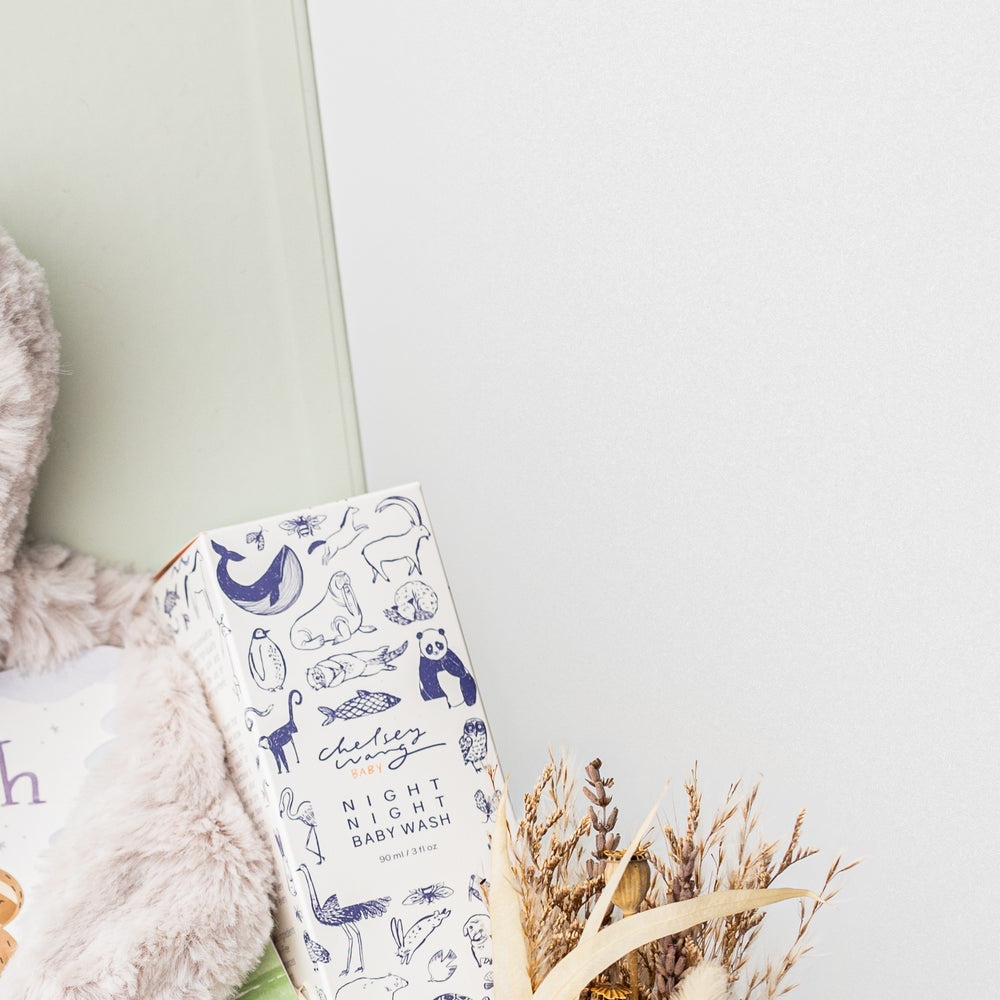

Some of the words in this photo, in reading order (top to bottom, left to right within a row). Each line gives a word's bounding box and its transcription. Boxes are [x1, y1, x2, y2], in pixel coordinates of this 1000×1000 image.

[351, 763, 383, 779] BABY
[342, 778, 440, 813] NIGHT
[347, 795, 445, 830] NIGHT
[352, 826, 395, 848] BABY
[400, 813, 451, 835] WASH
[379, 854, 392, 863] 90
[393, 851, 404, 860] ml
[411, 847, 418, 855] 3
